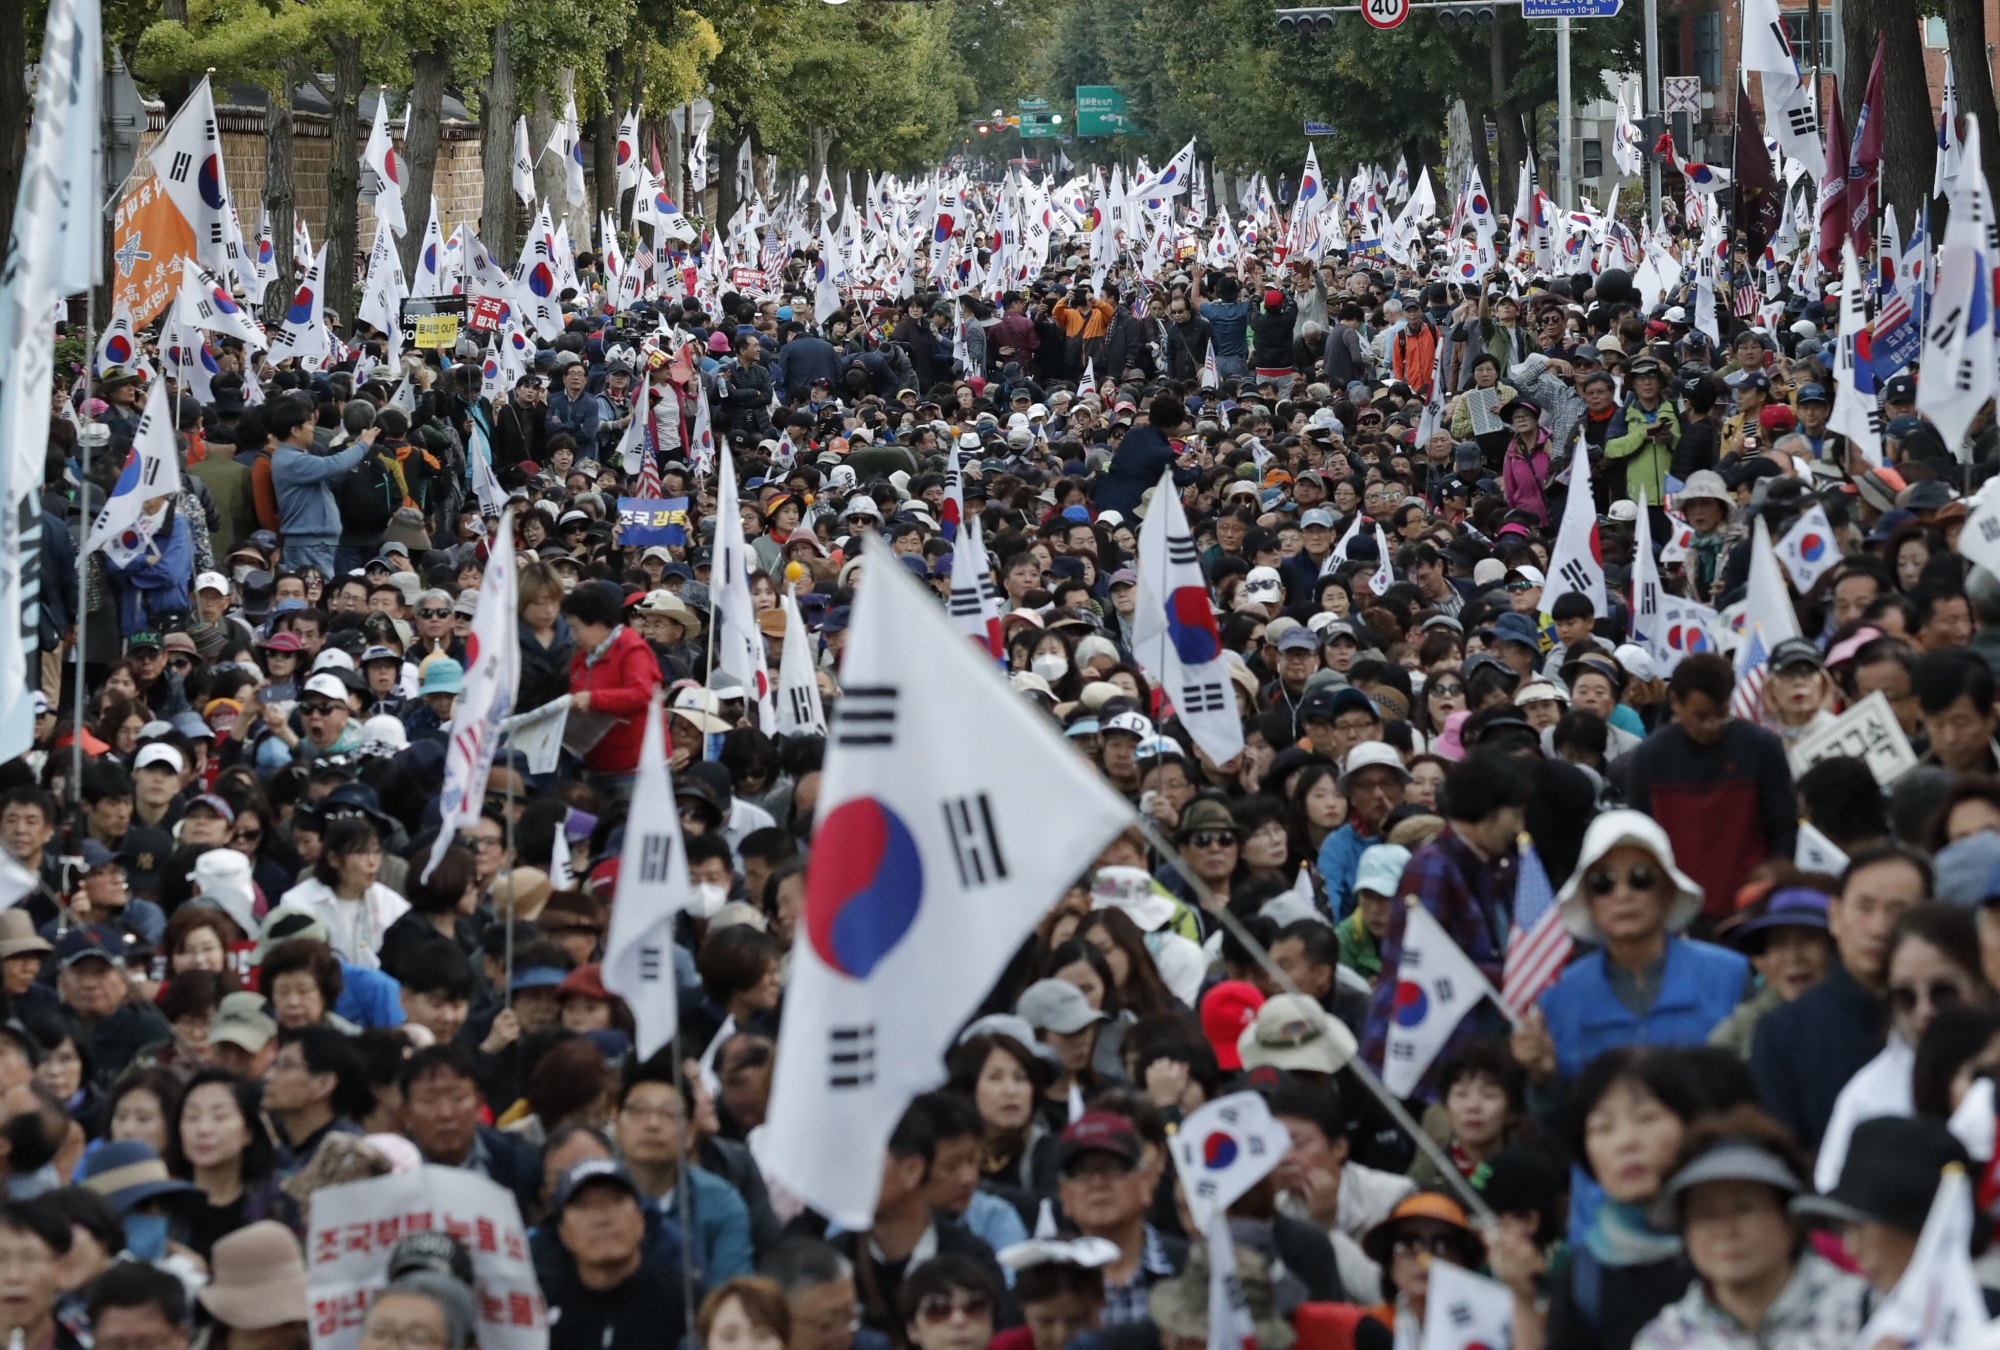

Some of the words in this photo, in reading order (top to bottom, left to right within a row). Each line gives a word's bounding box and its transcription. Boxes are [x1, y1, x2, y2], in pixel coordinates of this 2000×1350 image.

[1371, 0, 1398, 16] 40
[1527, 7, 1576, 15] Jahamun-ro
[1577, 6, 1600, 15] 10-gil
[480, 299, 501, 315] 조국
[418, 323, 440, 335] 문재인
[440, 323, 456, 334] OUT
[619, 509, 650, 527] 조국
